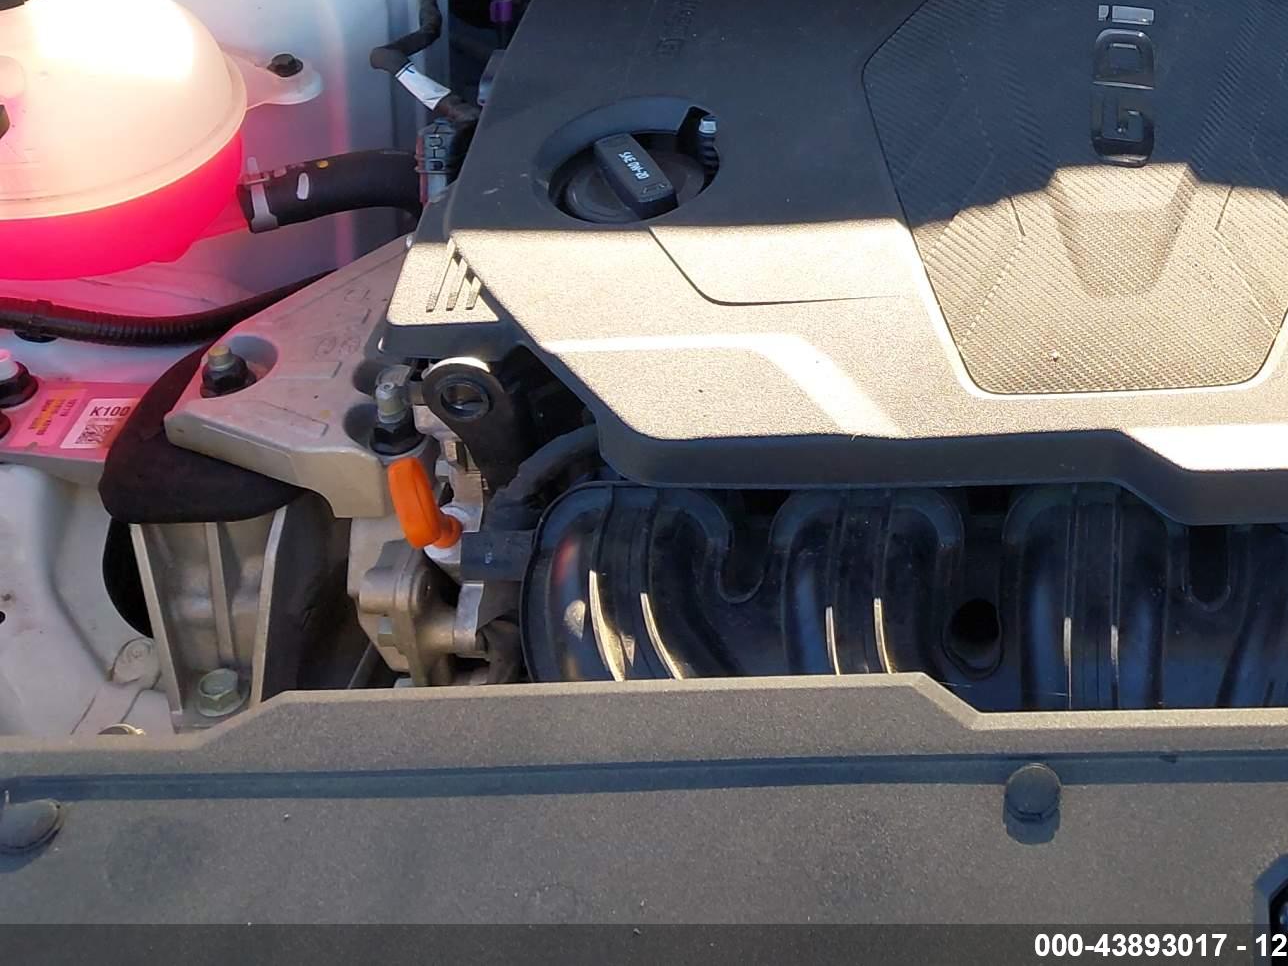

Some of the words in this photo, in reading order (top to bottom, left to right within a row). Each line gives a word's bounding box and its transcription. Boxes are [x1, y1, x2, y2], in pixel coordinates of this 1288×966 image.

[1091, 4, 1155, 168] GDi
[618, 151, 637, 164] SAE
[89, 406, 131, 417] K100
